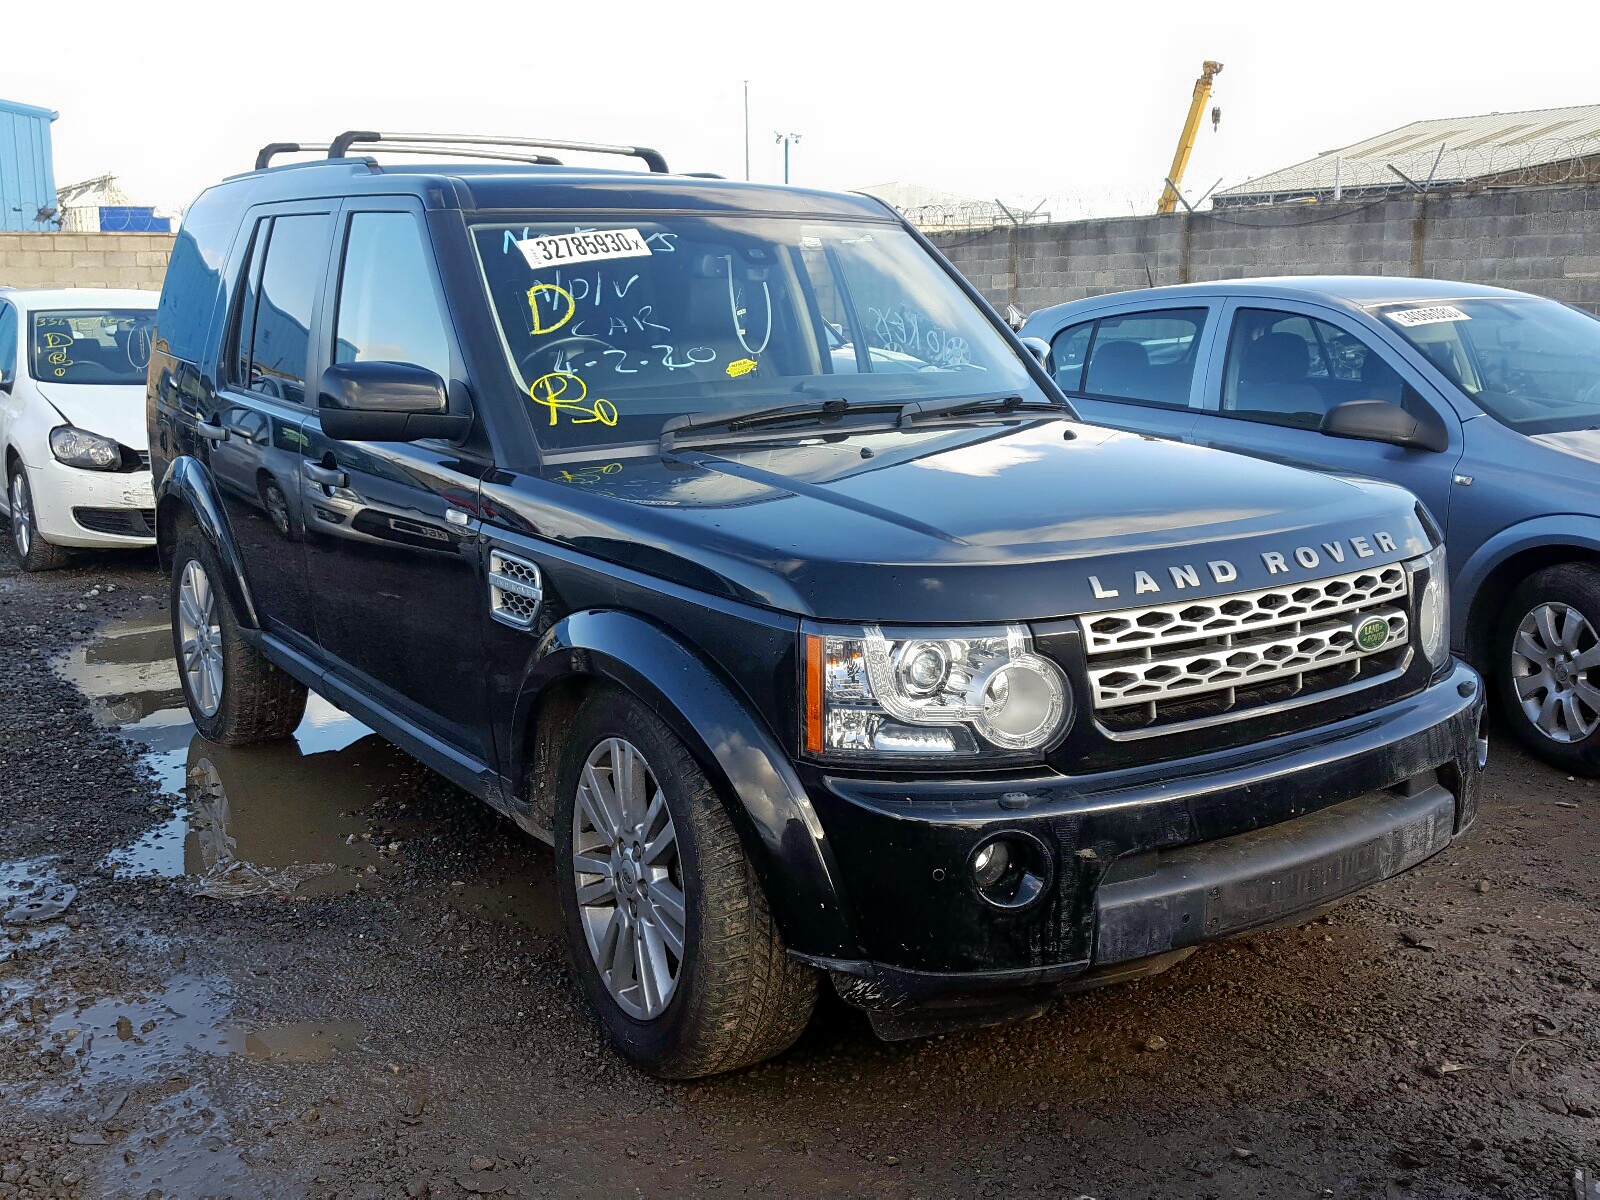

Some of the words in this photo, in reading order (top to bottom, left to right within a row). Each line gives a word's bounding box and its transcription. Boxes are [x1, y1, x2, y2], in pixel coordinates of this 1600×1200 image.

[526, 284, 576, 336] D
[571, 305, 671, 337] CAR
[1087, 559, 1239, 600] LAND
[1260, 530, 1398, 575] ROVER
[1364, 623, 1380, 635] LAND
